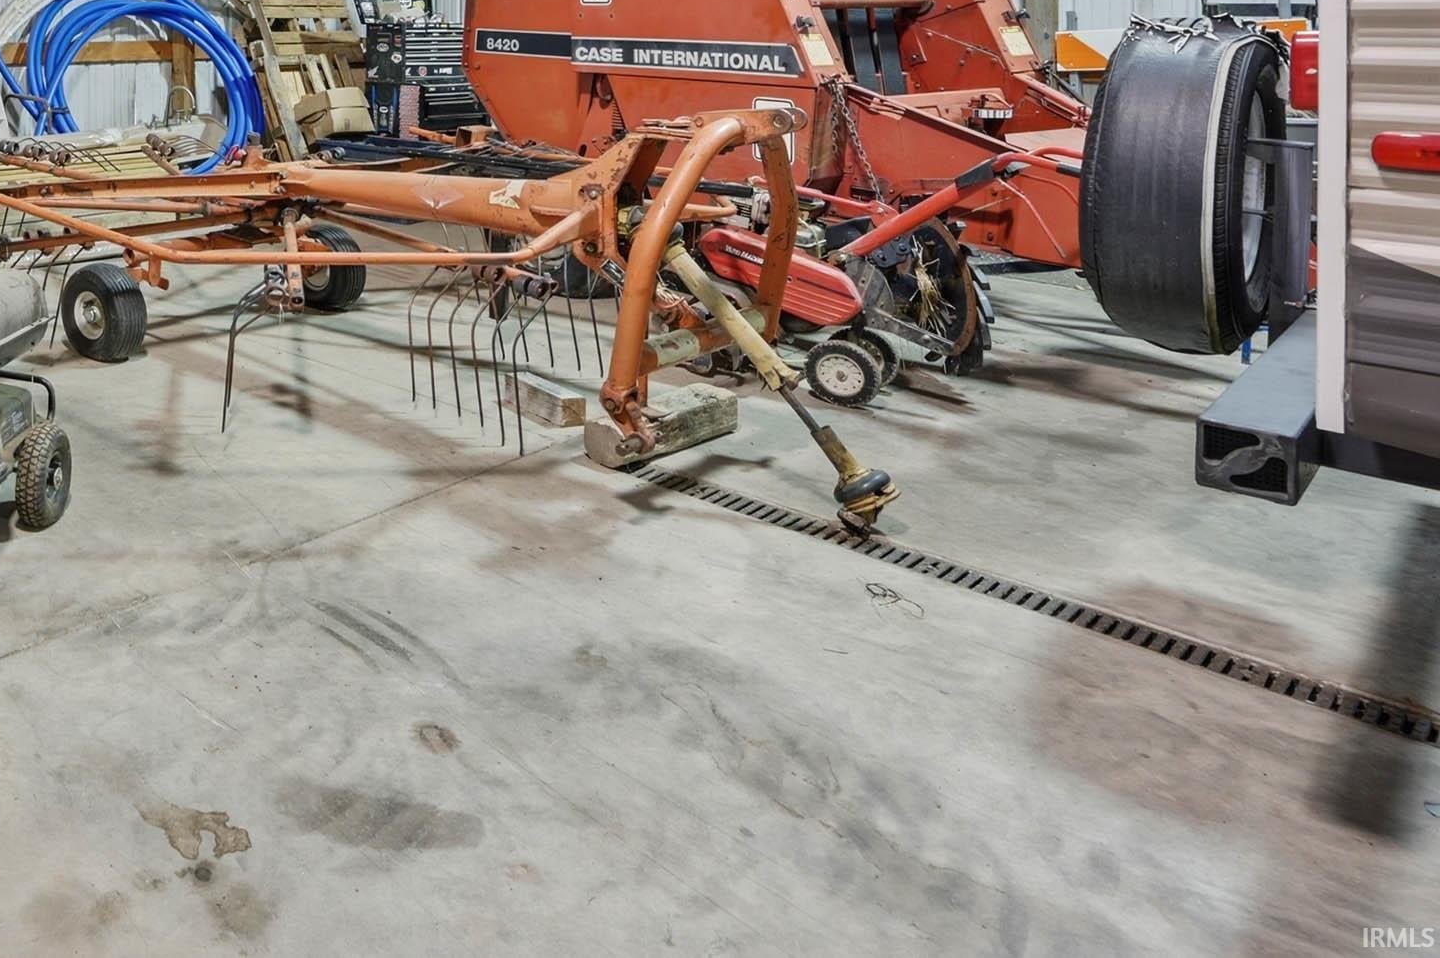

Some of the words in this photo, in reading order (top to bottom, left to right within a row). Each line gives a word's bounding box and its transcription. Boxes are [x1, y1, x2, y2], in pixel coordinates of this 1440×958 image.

[486, 37, 520, 52] 8420
[575, 45, 623, 63] CASE
[633, 47, 786, 72] INTERNATIONAL
